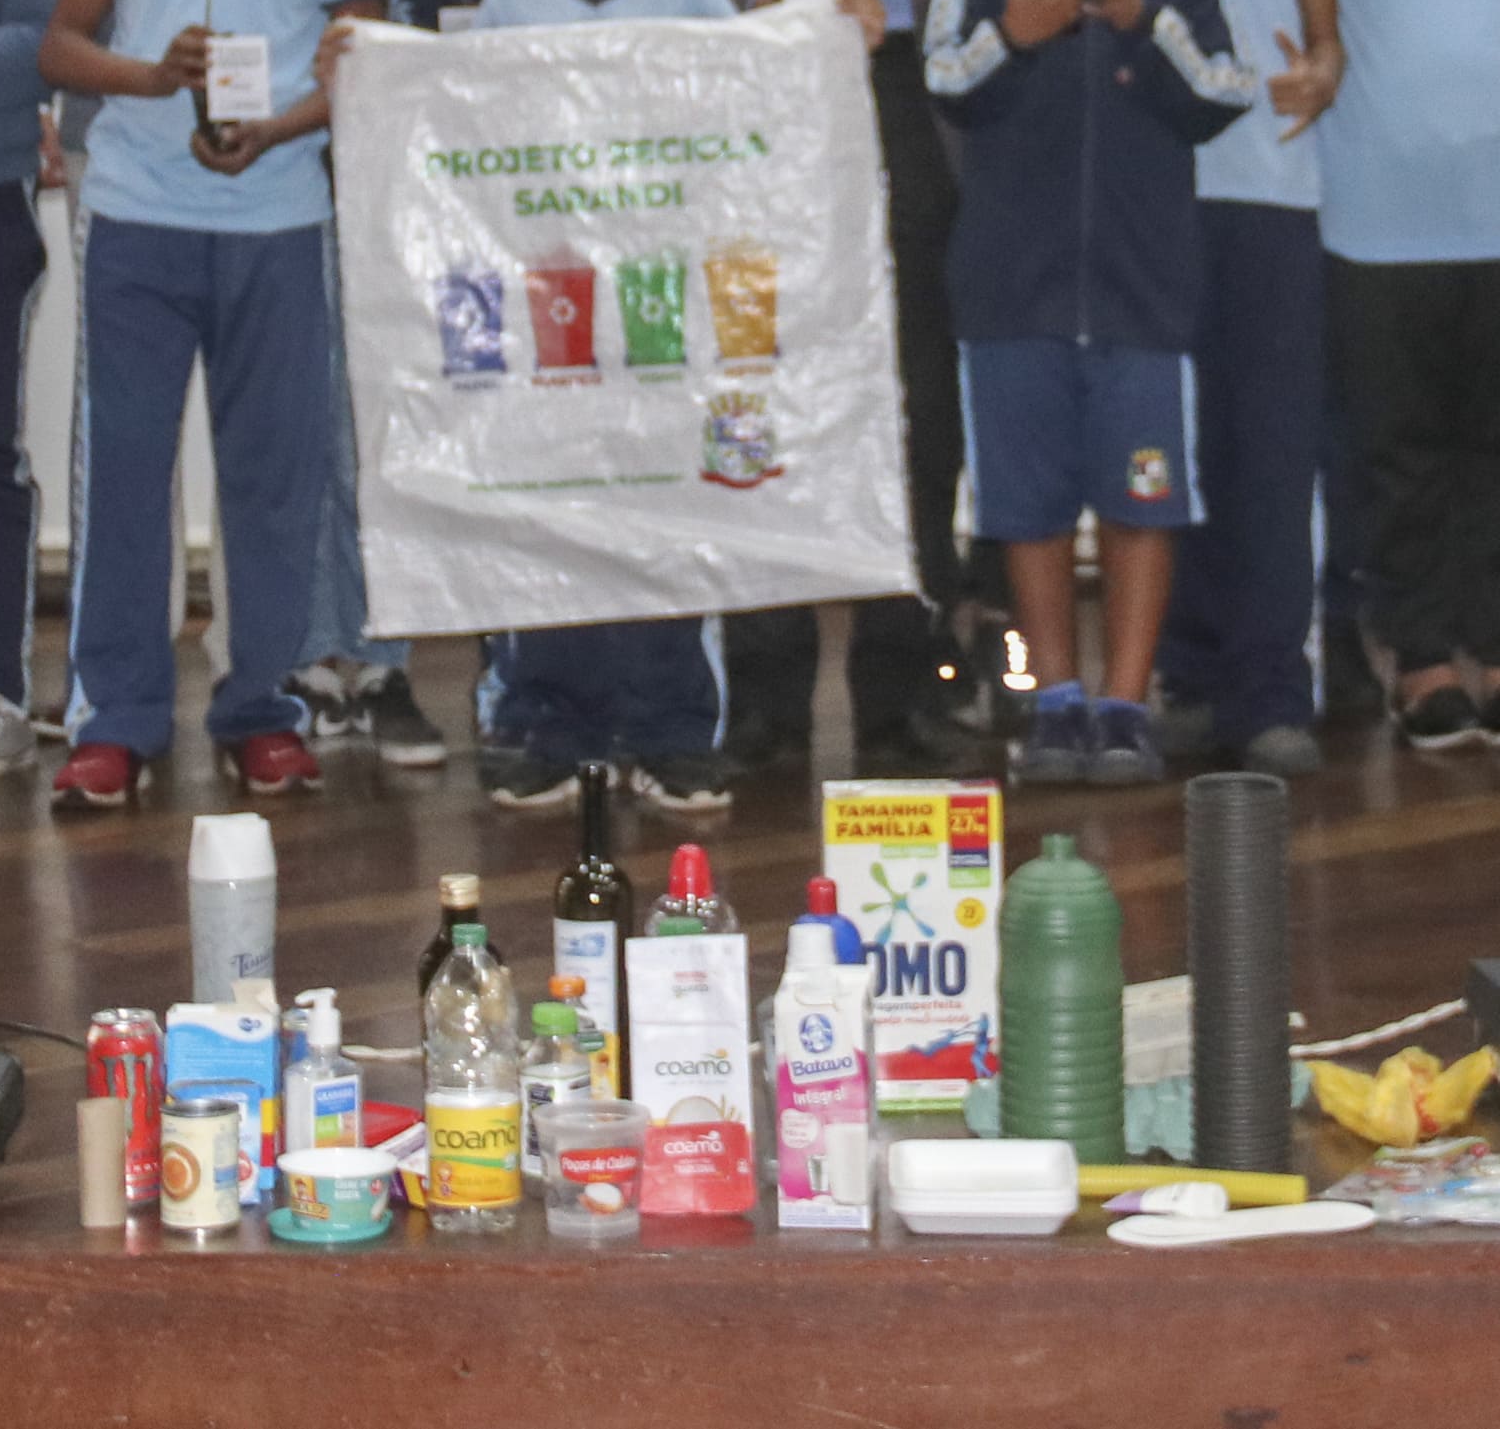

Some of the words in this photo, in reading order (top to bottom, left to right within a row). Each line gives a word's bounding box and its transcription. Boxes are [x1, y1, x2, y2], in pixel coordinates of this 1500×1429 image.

[426, 142, 597, 177] PROJETO
[514, 180, 685, 217] SARANDI
[836, 803, 934, 818] TAMANHO
[836, 819, 933, 837] FAMÍLIA
[863, 941, 967, 998] OMO
[655, 1059, 732, 1076] coamo
[791, 1056, 853, 1077] Batavo
[434, 1124, 517, 1149] coamo
[663, 1138, 724, 1155] coamo
